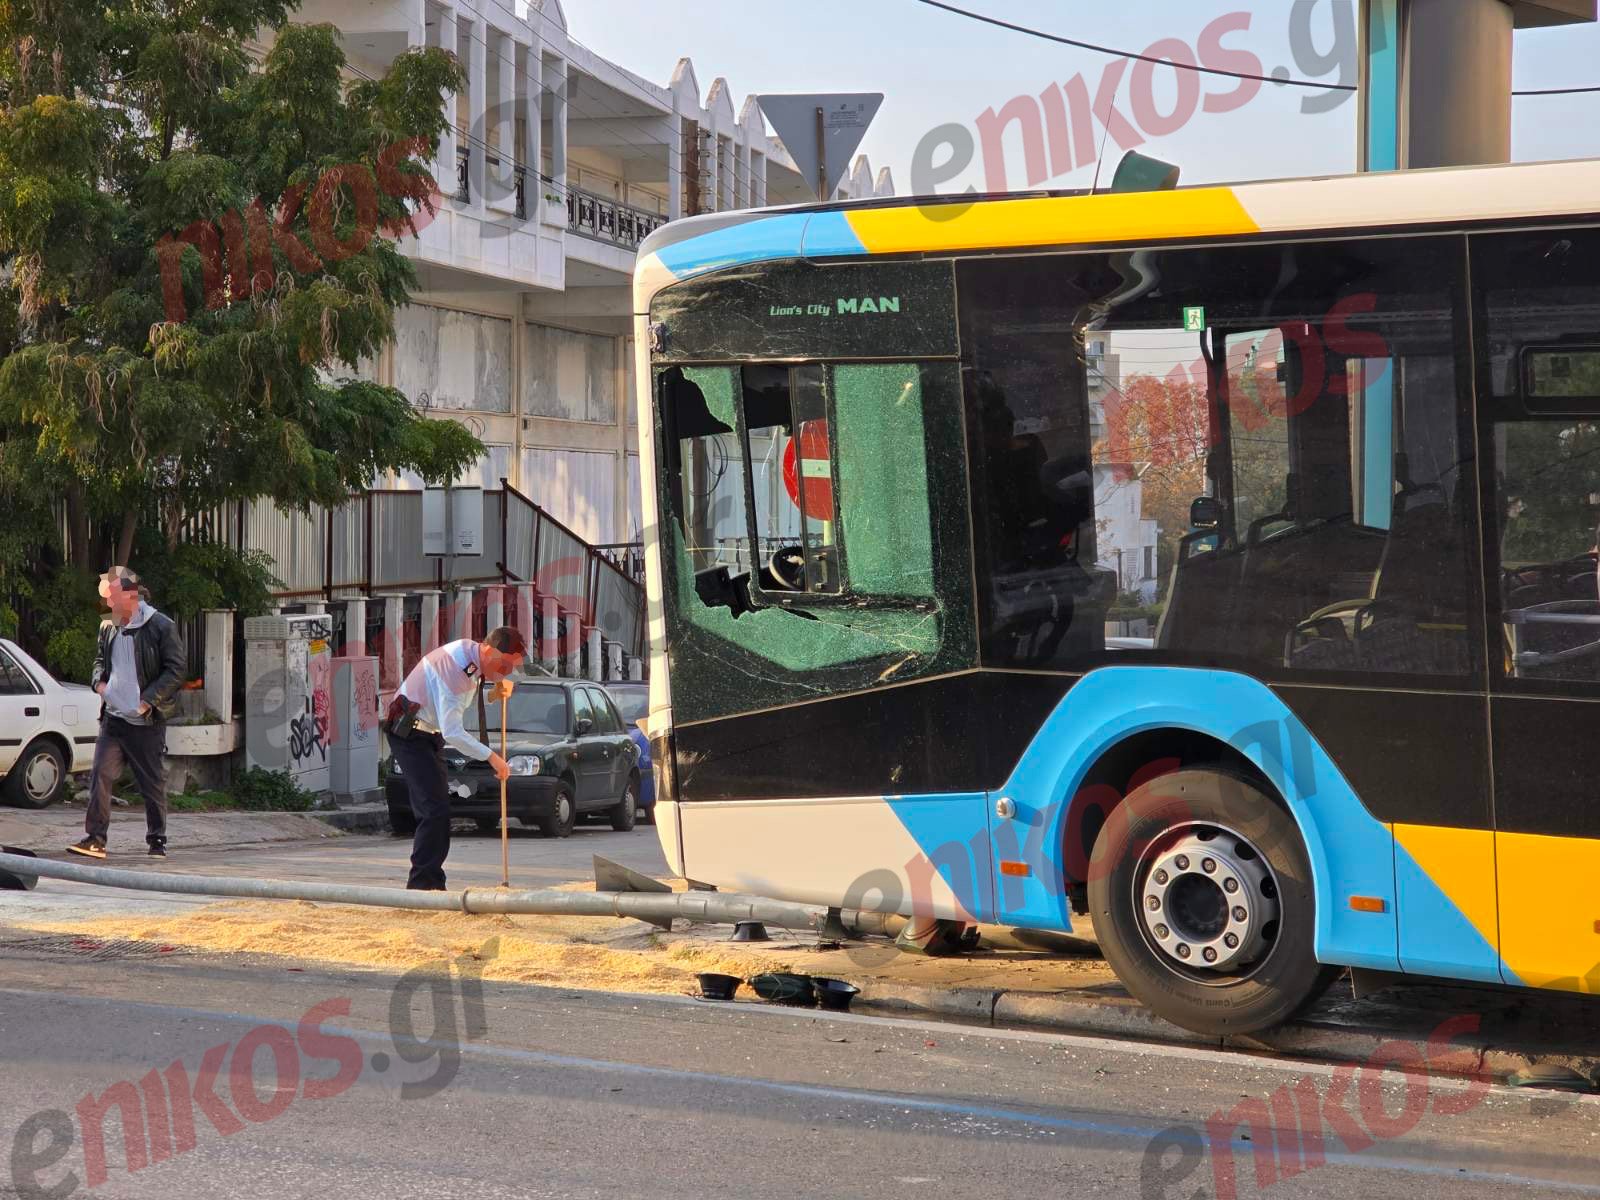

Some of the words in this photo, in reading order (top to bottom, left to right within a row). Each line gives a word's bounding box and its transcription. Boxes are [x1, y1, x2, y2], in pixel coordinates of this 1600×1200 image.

[770, 305, 802, 316] Lion's
[807, 304, 830, 316] City
[837, 296, 900, 314] MAN
